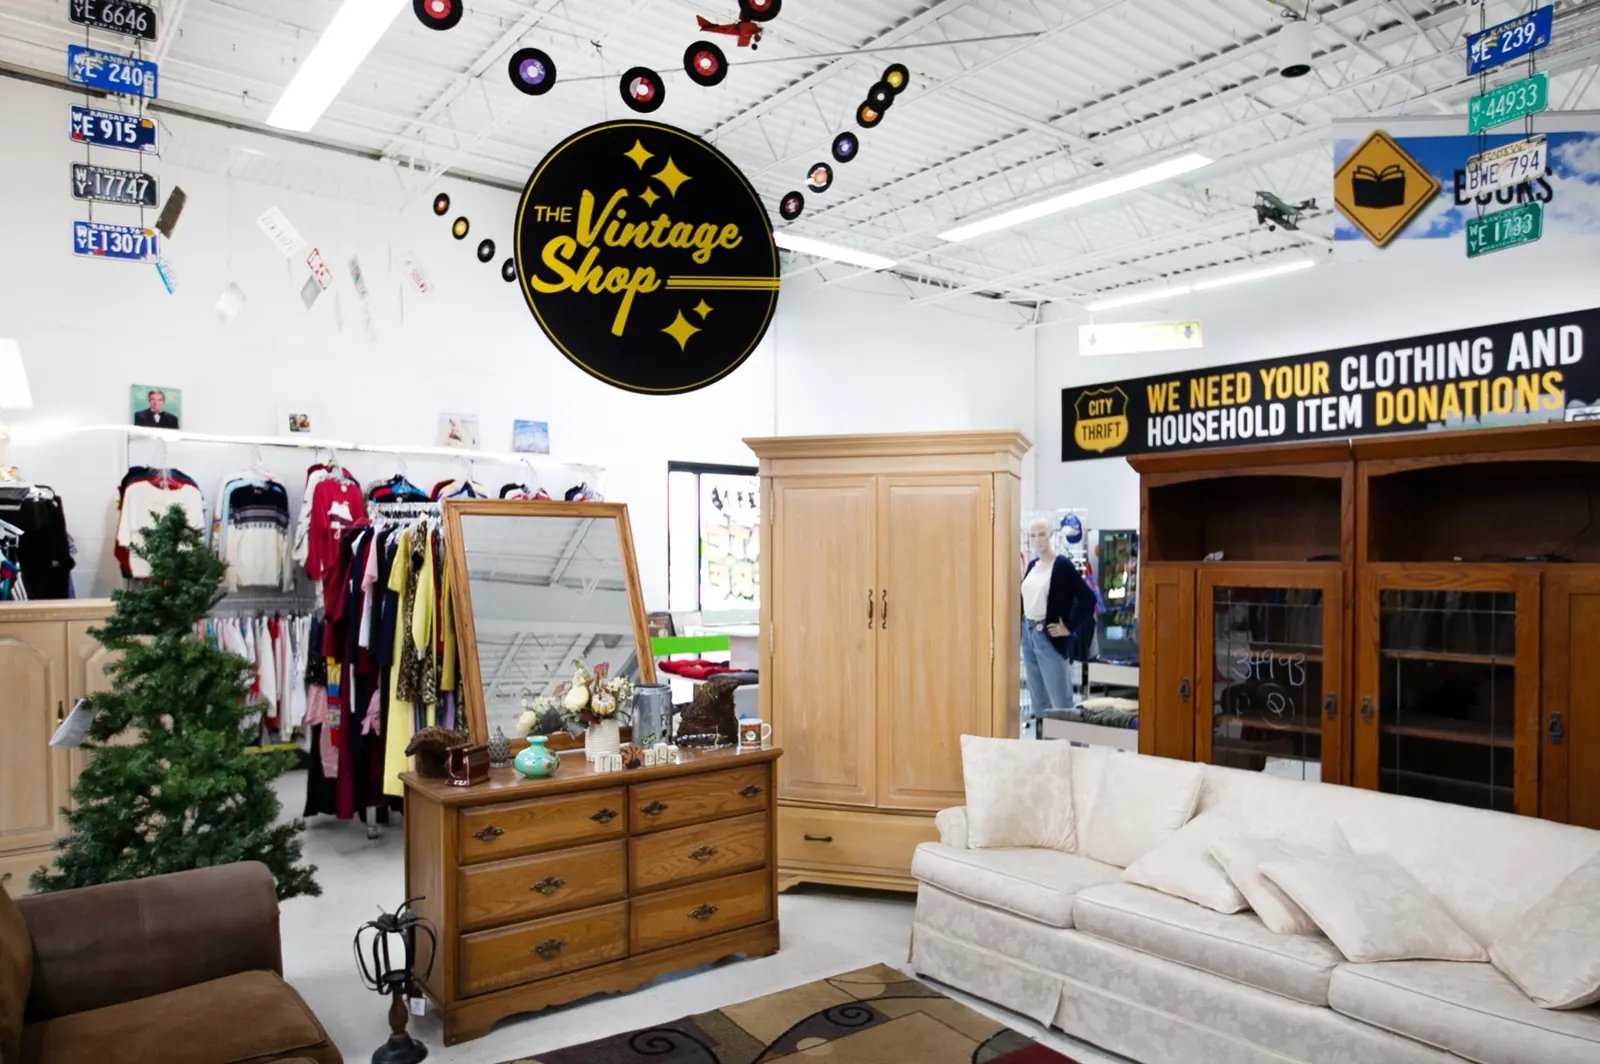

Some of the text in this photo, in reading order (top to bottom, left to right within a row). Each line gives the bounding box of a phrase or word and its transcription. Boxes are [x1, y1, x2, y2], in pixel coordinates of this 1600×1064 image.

[102, 4, 147, 31] 6646
[1502, 22, 1535, 53] 239
[109, 63, 142, 87] 240
[90, 110, 125, 122] KANSAS
[1486, 83, 1537, 120] 44933
[101, 120, 137, 143] 915
[1470, 150, 1539, 190] BWE 794
[534, 188, 743, 264] THE Vintage
[1494, 213, 1533, 242] 1733
[531, 235, 661, 337] Shop
[1147, 324, 1583, 414] WE NEED YOUR CLOTHING AND
[1088, 397, 1113, 417] CITY
[1147, 370, 1564, 447] HOUSEHOLD ITEM DONATIONS
[1081, 421, 1122, 441] THRIFT
